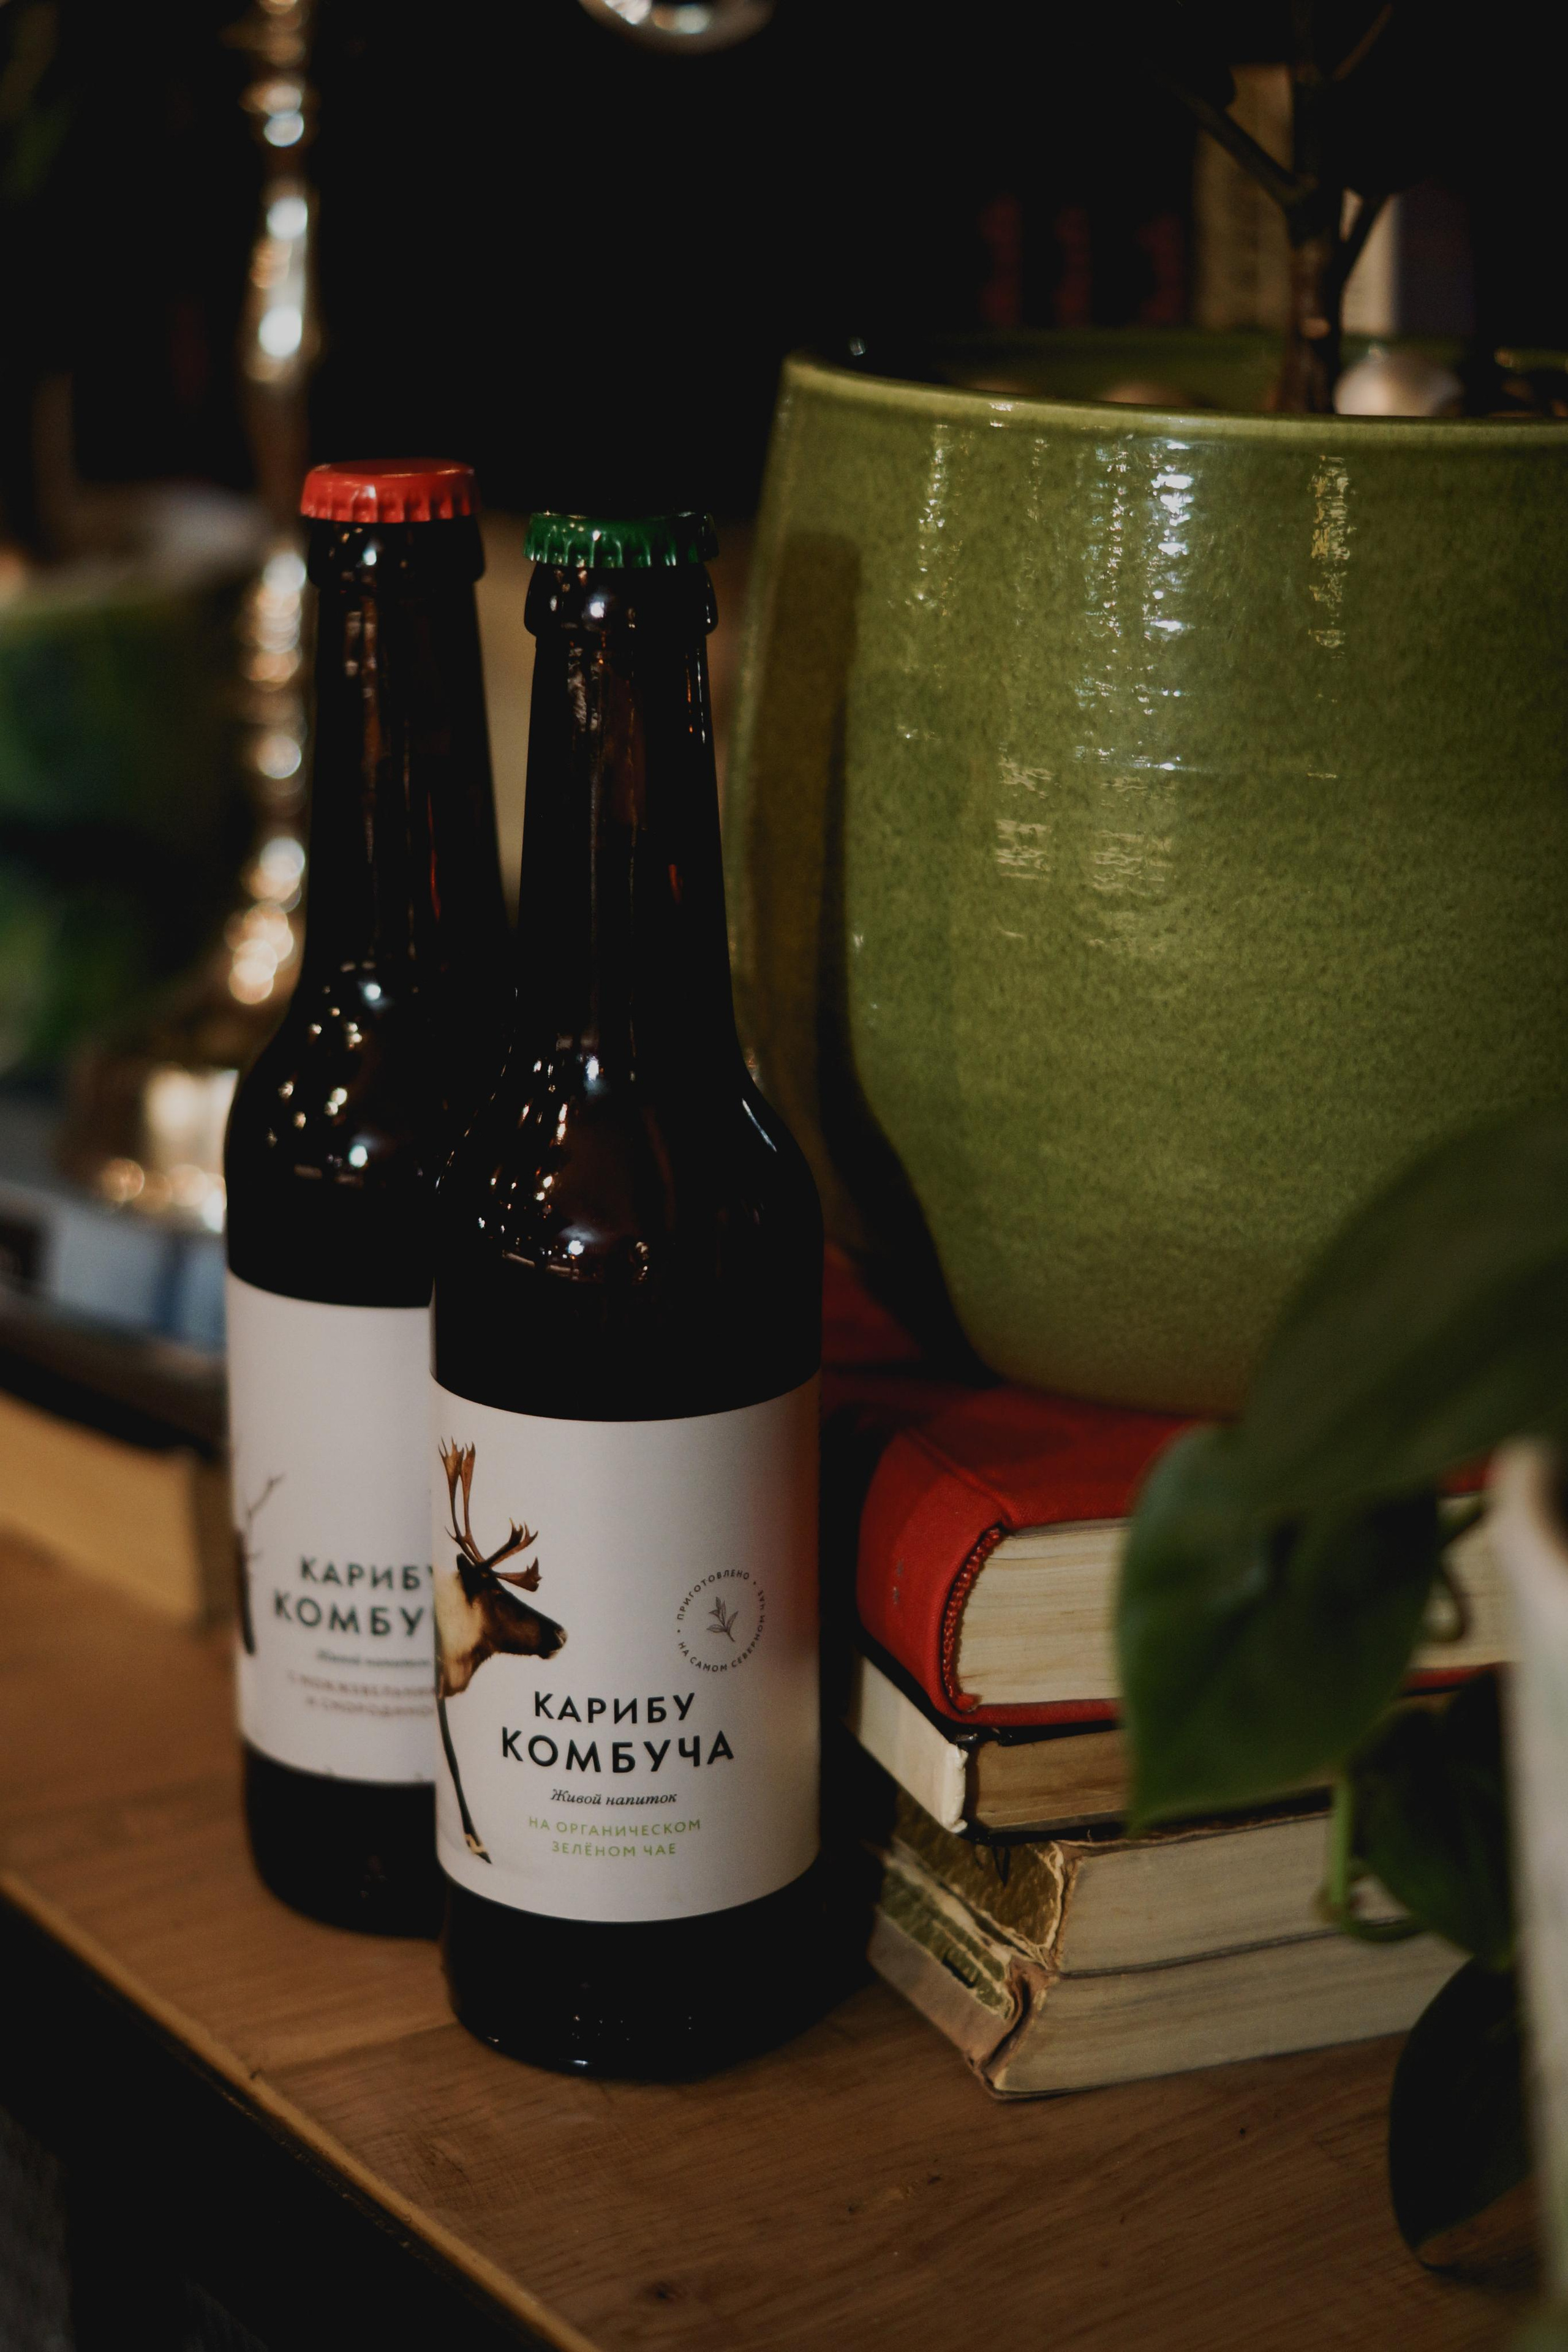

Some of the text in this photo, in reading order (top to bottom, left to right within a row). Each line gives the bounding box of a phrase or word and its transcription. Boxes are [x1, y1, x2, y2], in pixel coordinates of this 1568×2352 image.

[300, 1556, 433, 1591] КАРИБ
[677, 1569, 750, 1620] ПРИГОТОВЛЕНО
[678, 1642, 690, 1657] НА
[690, 1656, 728, 1672] САМОМ
[731, 1615, 765, 1667] СЕВЕРНОМ
[534, 1691, 695, 1724] КАРИБУ
[502, 1726, 734, 1773] КОМБУЧА
[551, 1789, 677, 1806] Живой напиток
[528, 1815, 701, 1836] НА ОРГАНИЧЕСКОМ
[551, 1840, 677, 1857] ЗЕЛЁНОМ ЧАЕ
